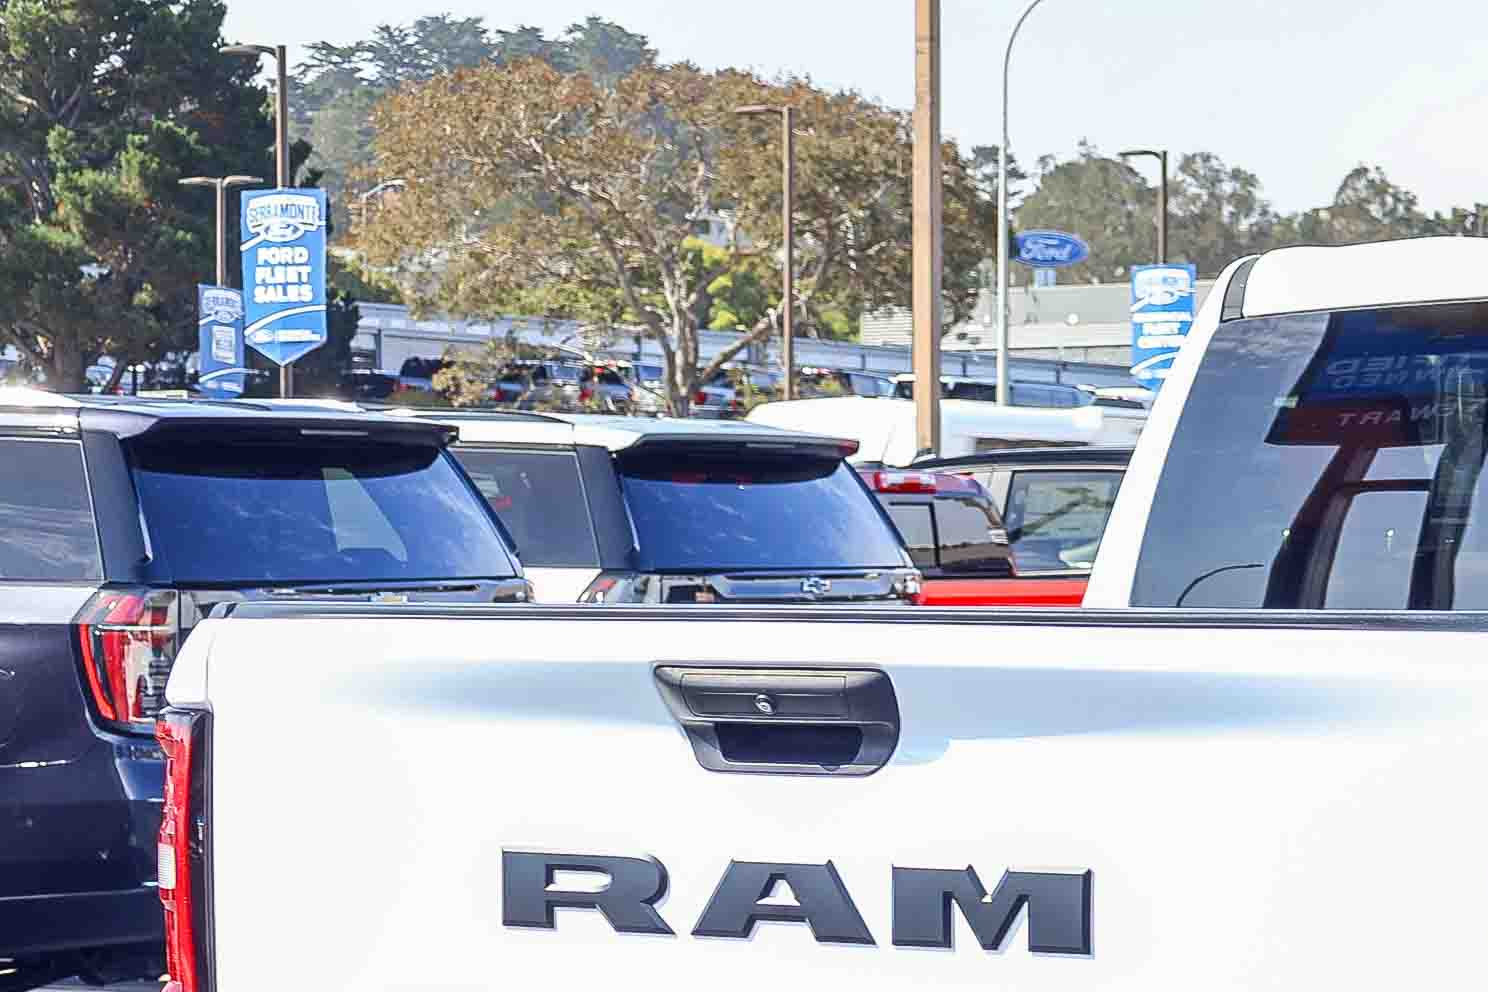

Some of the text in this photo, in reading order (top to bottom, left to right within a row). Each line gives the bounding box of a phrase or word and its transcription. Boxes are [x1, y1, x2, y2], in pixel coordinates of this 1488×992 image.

[256, 246, 309, 265] FORD
[255, 266, 312, 284] FLEET
[254, 284, 313, 304] SALES
[502, 849, 1093, 956] RAM
